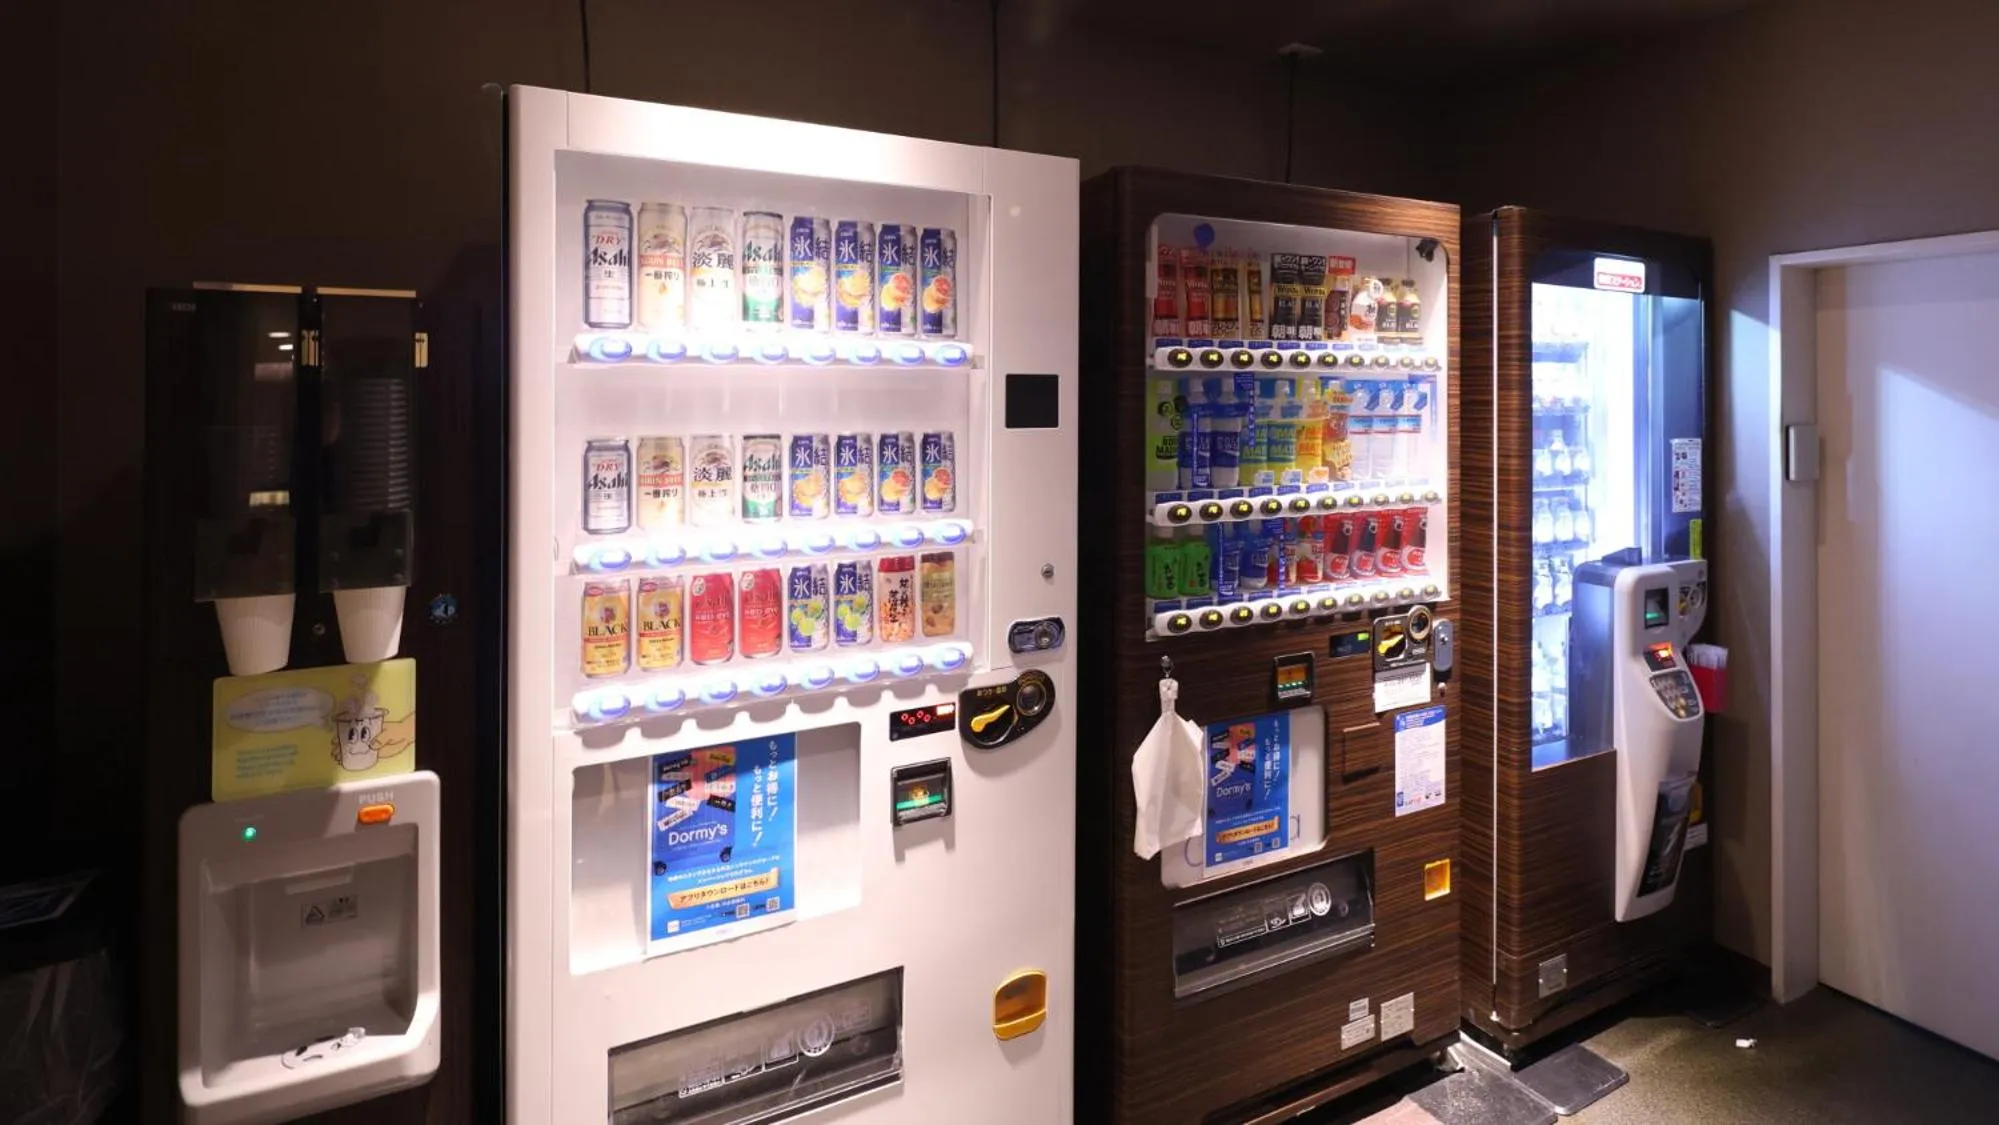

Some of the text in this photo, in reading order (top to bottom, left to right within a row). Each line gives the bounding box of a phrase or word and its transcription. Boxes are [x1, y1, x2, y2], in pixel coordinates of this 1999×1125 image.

[587, 247, 630, 268] Asahi
[692, 251, 733, 269] 淡麗
[743, 453, 782, 472] Asahi
[586, 472, 629, 490] Asahi
[693, 467, 733, 482] 淡麗
[588, 622, 631, 636] BLACK
[643, 618, 681, 631] BLACK
[358, 790, 395, 804] PUSH
[1216, 782, 1252, 798] Dormy's
[668, 823, 729, 845] Dormy's
